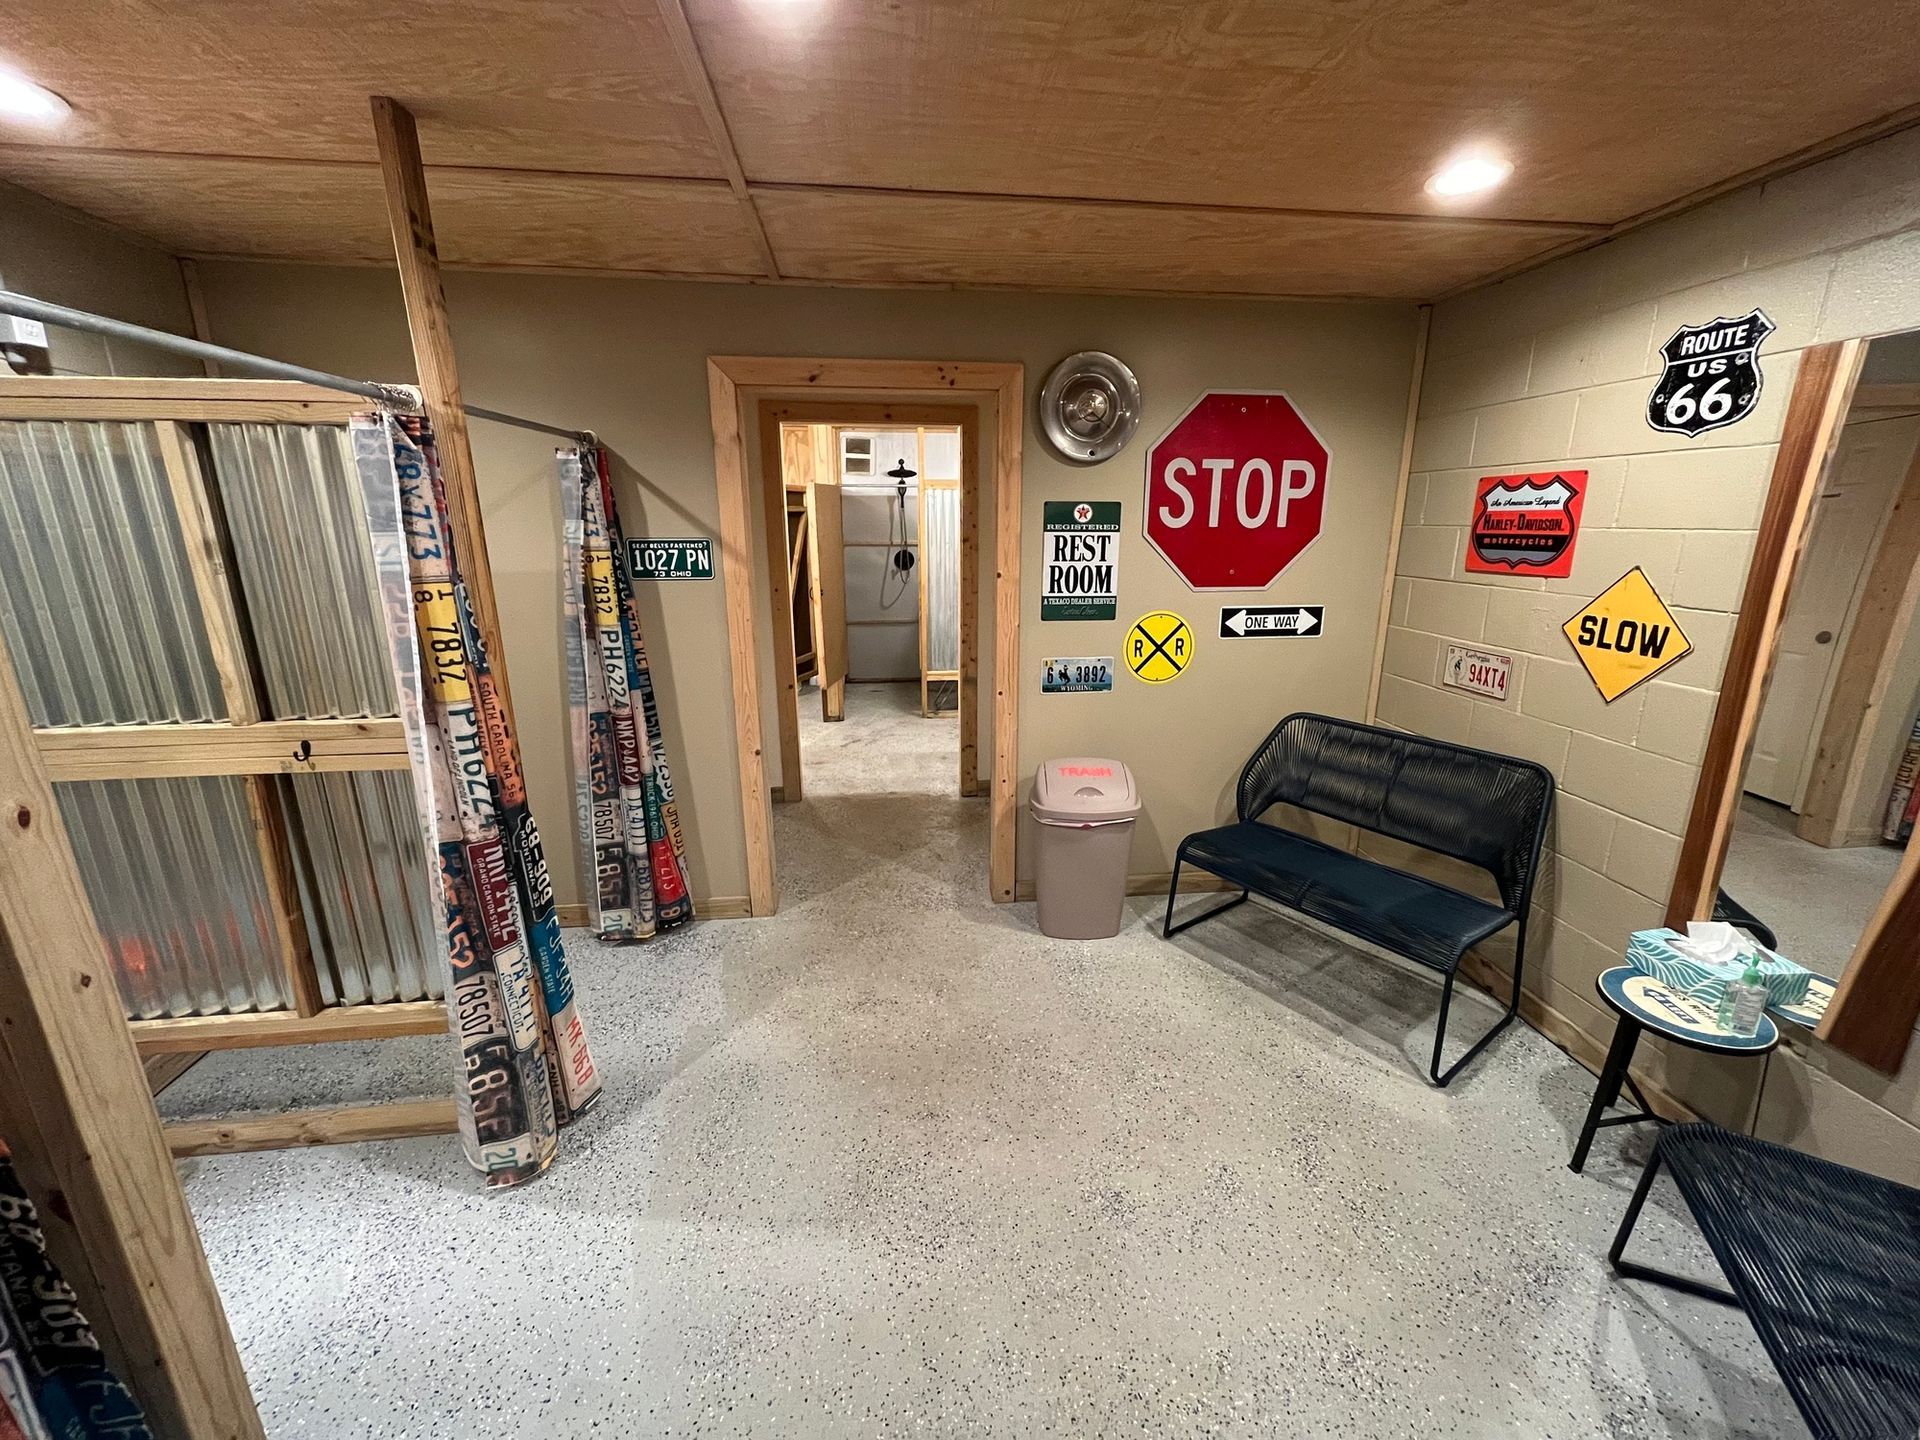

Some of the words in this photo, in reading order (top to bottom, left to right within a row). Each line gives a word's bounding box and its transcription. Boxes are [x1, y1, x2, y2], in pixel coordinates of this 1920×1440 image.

[1680, 324, 1750, 356] ROUTE
[1687, 358, 1728, 378] US
[1666, 377, 1732, 425] 66
[1158, 457, 1316, 529] STOP
[1503, 498, 1533, 507] American
[1535, 496, 1561, 508] Legend
[1053, 535, 1111, 562] REST
[1483, 537, 1553, 546] motorcycles
[634, 549, 679, 570] 1027
[686, 549, 709, 570] PN
[1048, 565, 1113, 593] ROOM
[591, 576, 613, 618] 7832
[1245, 616, 1269, 629] ONE
[1273, 615, 1299, 628] WAY
[1578, 614, 1670, 659] SLOW
[426, 621, 467, 685] 7832
[1134, 639, 1143, 657] R
[1175, 638, 1184, 656] R
[600, 629, 629, 711] PH6224
[1047, 666, 1053, 684] 6
[1076, 666, 1106, 683] 3892
[1469, 663, 1506, 691] 94XT4
[1060, 684, 1094, 692] WYOMING
[481, 681, 498, 722] SOUTH
[490, 722, 514, 781] CAROLINA
[616, 720, 636, 751] NKP
[1058, 767, 1113, 777] TRASH
[594, 801, 615, 841] 78507
[476, 857, 489, 886] GRAND
[519, 829, 537, 887] MONTANA
[482, 885, 496, 914] CANYON
[490, 913, 502, 938] STATE
[537, 946, 550, 973] GARDEN
[544, 973, 557, 995] STATE
[455, 975, 494, 1039] 78507
